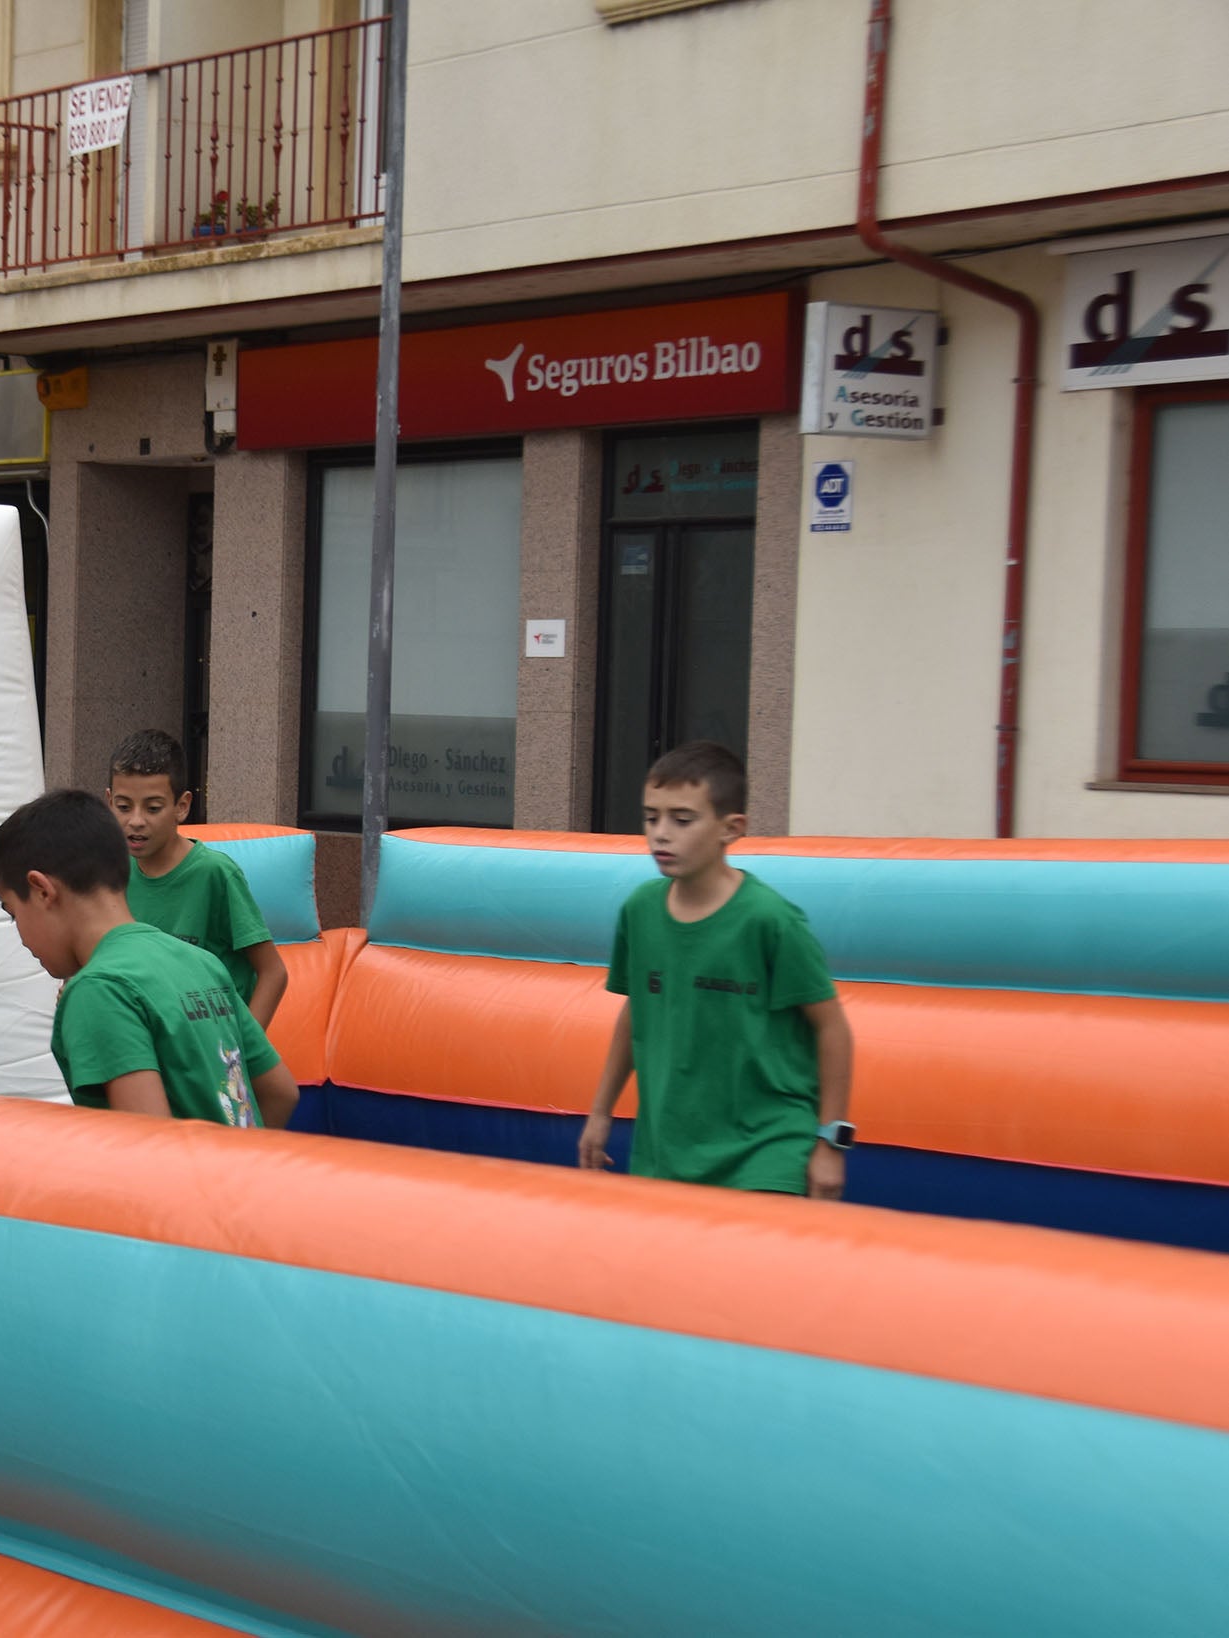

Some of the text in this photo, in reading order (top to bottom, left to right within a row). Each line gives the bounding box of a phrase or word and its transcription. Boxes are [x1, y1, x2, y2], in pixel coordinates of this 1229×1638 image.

[71, 82, 130, 117] SE VENDE
[527, 336, 761, 397] Seguros Bilbao
[835, 385, 920, 408] Asesoría
[828, 409, 925, 430] y Gestión
[821, 478, 845, 494] ADT
[445, 746, 507, 773] Sánchez
[458, 778, 507, 797] Gestión
